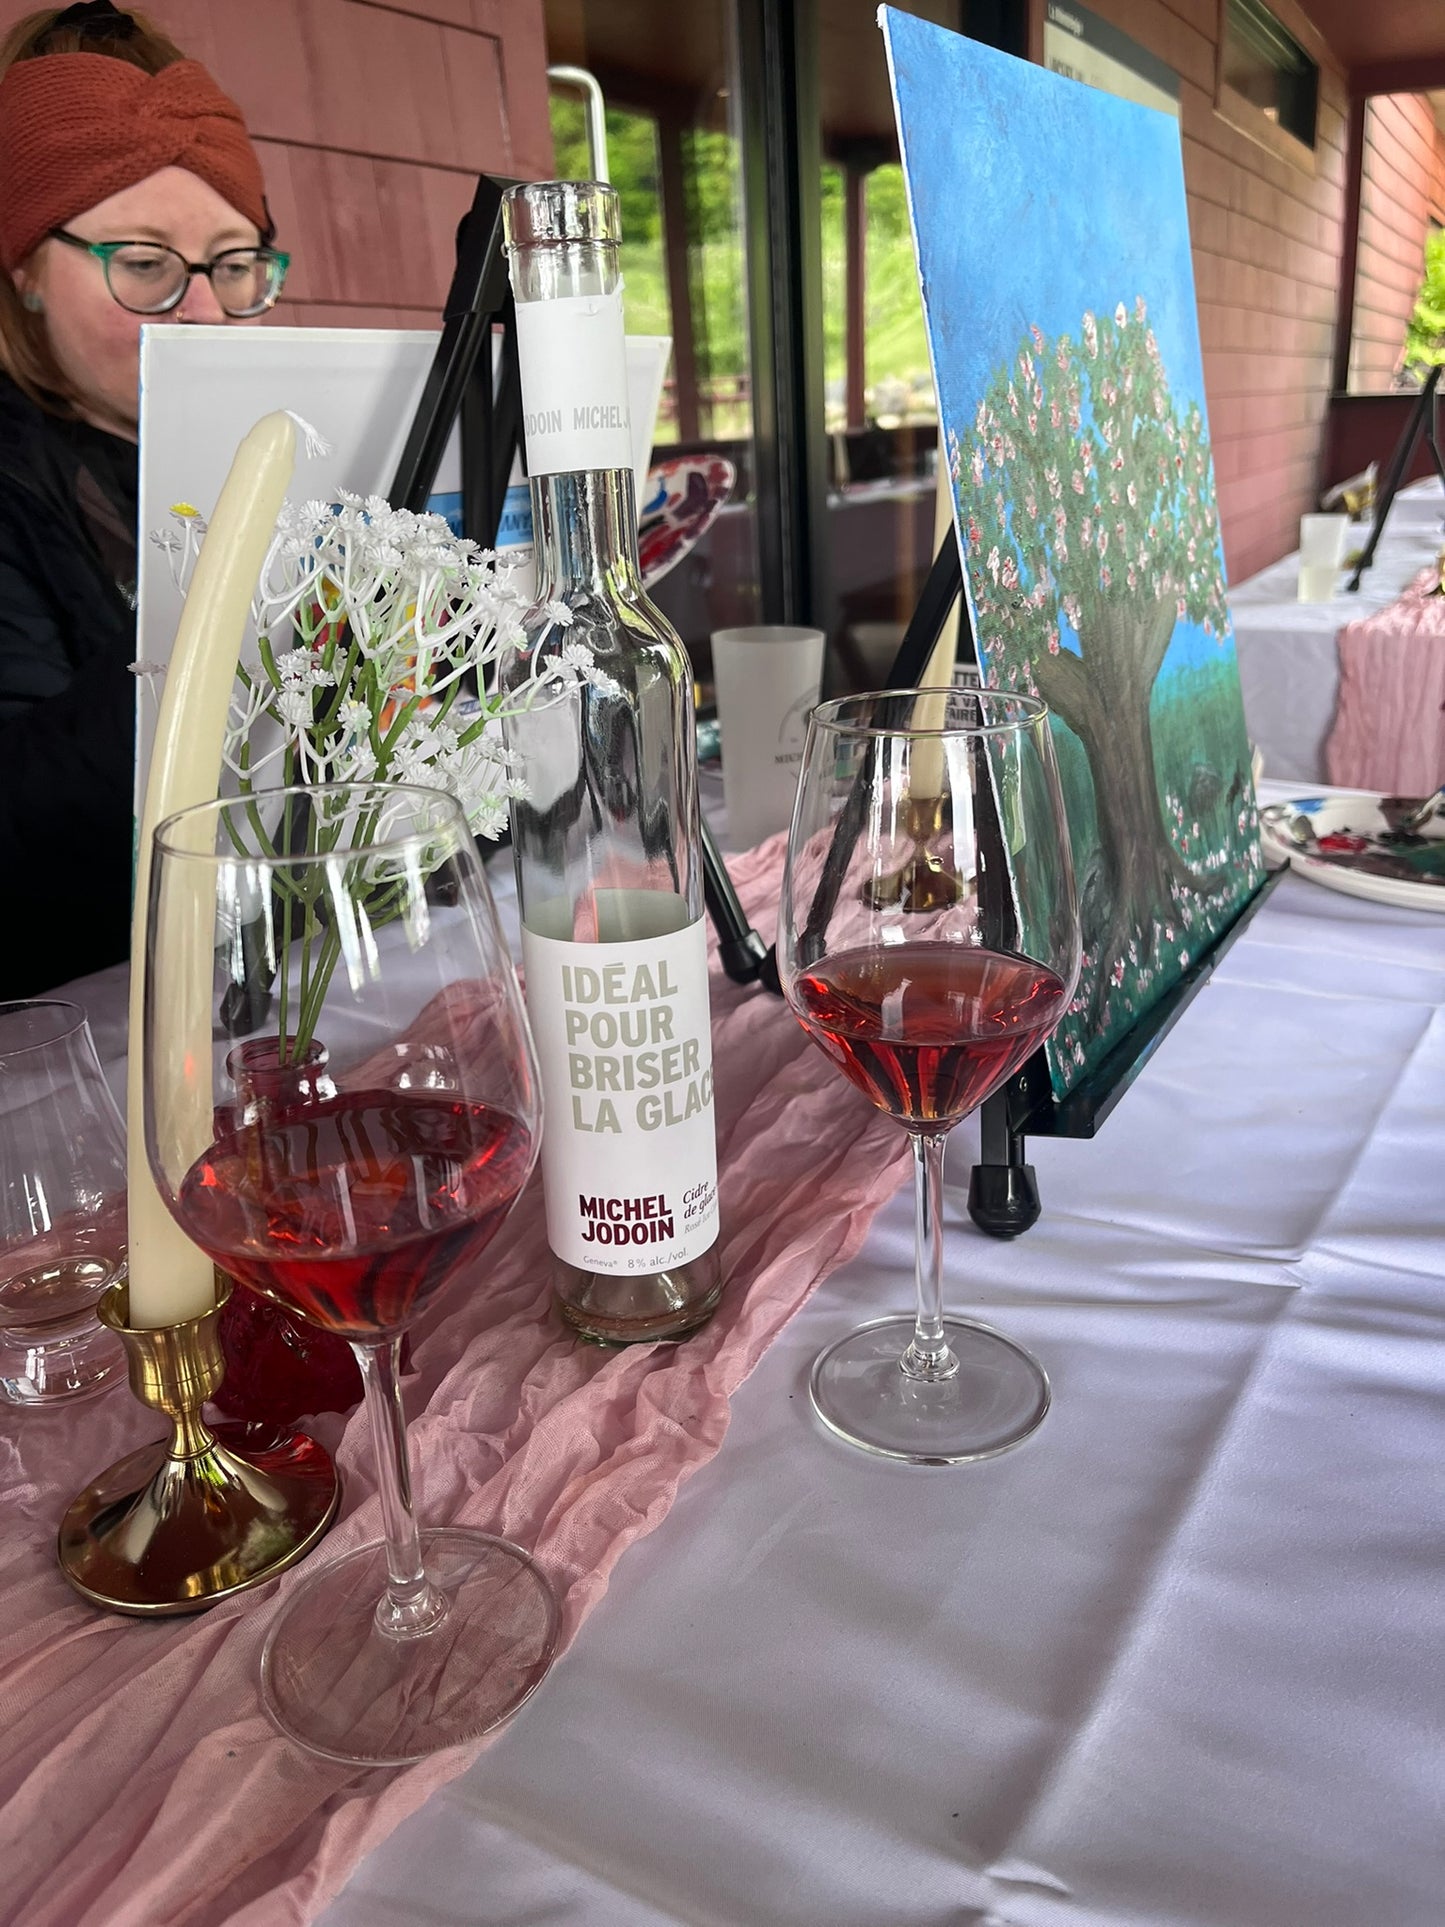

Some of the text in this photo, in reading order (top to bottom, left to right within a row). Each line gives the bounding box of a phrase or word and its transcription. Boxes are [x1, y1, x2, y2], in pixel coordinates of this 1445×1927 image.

[525, 410, 562, 436] ODOIN
[573, 405, 622, 430] MICHEL
[562, 960, 678, 1004] IDÉAL
[565, 1005, 674, 1049] POUR
[569, 1038, 700, 1091] BRISER
[572, 1096, 622, 1134] LA
[579, 1194, 672, 1221] MICHEL
[683, 1181, 709, 1204] Cidre
[684, 1204, 697, 1219] de
[581, 1216, 675, 1245] JODOIN
